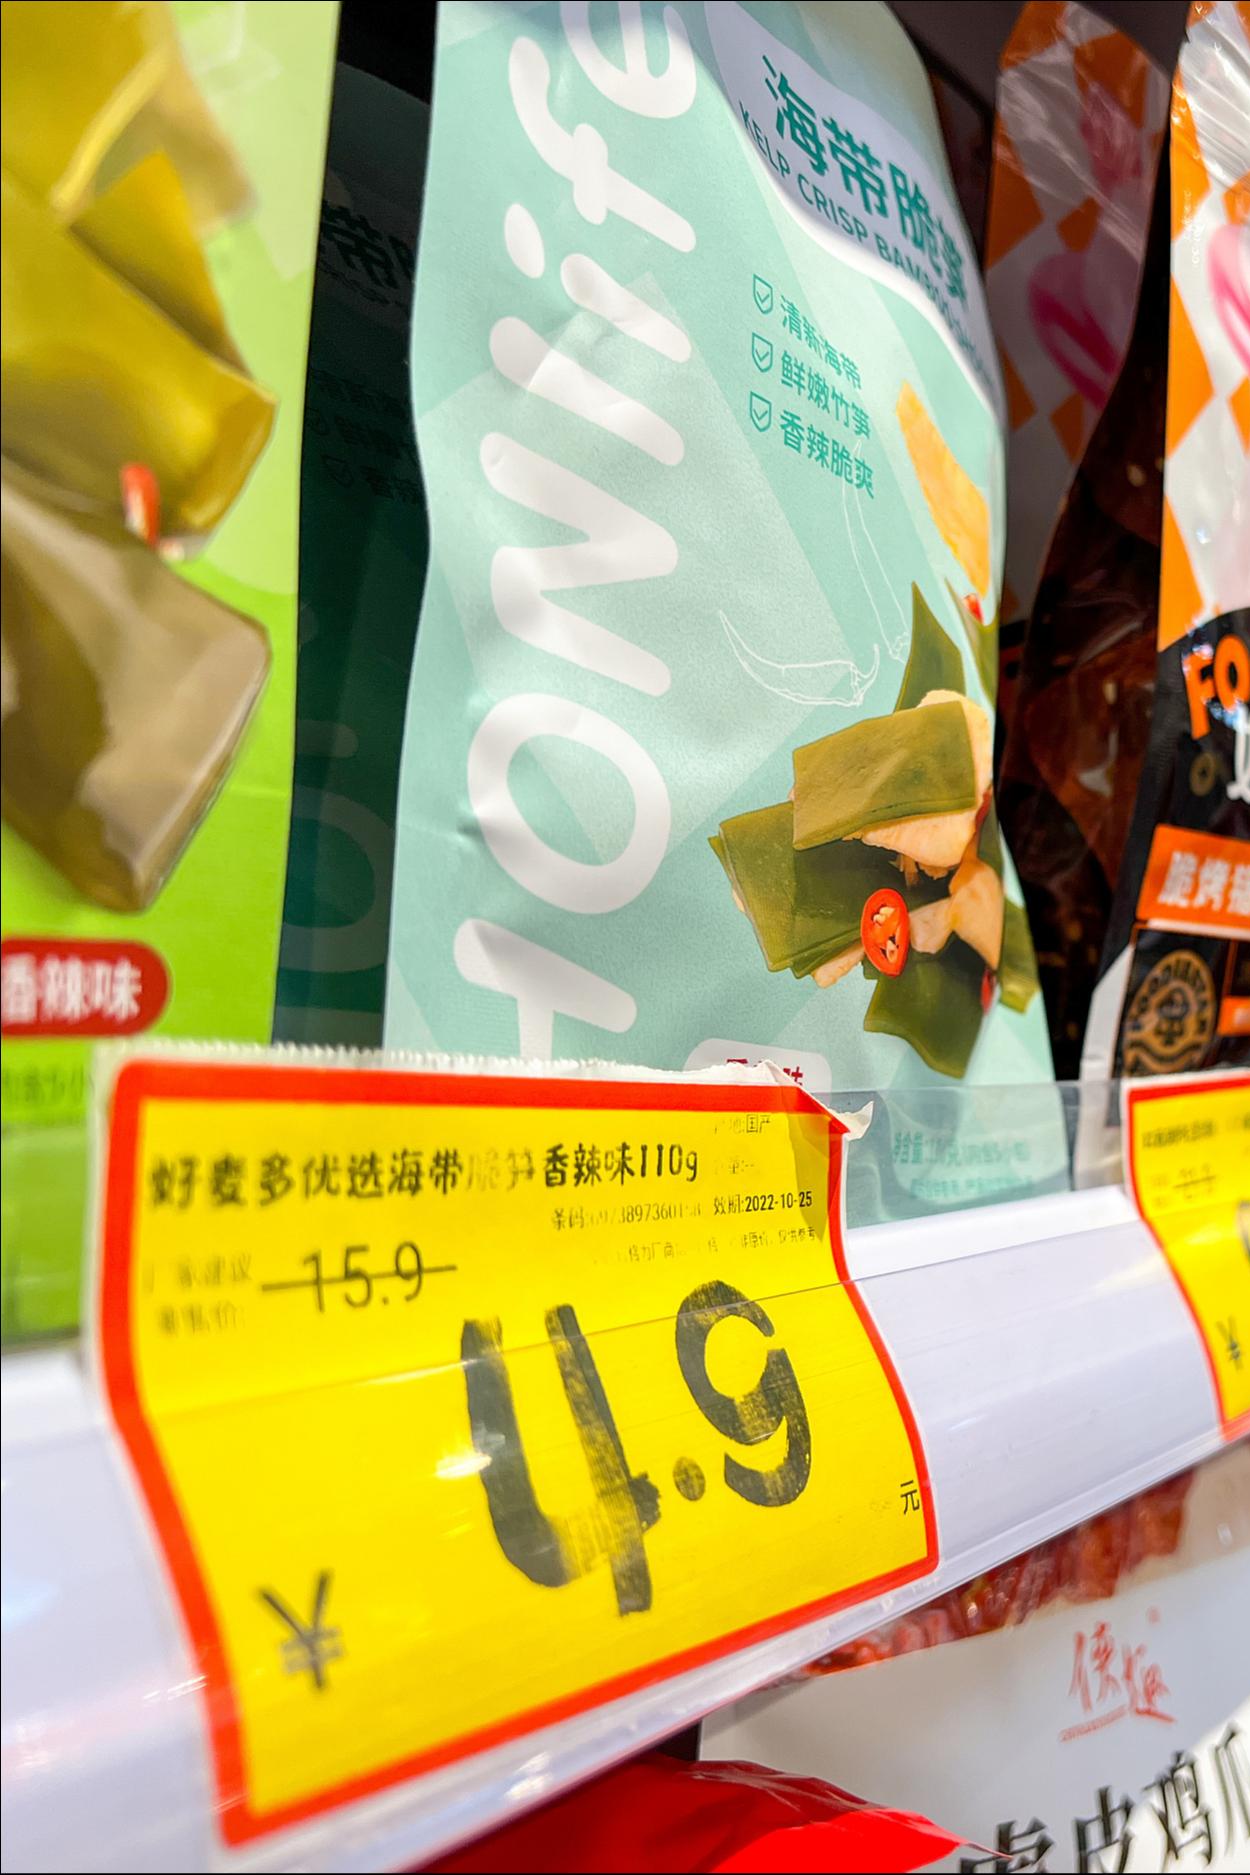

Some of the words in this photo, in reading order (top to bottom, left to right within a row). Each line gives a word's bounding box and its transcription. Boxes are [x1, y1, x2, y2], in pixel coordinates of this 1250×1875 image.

[738, 100, 791, 178] KELP
[797, 172, 869, 243] CRISP
[762, 55, 970, 311] 海带脆笋
[780, 294, 862, 390] 清新海带
[780, 350, 871, 439] 鲜嫩竹笋
[779, 409, 875, 500] 香辣脆爽
[303, 1240, 424, 1314] 15.9
[459, 1279, 812, 1618] 4.9
[900, 1480, 921, 1515] 元
[256, 1569, 345, 1692] ¥
